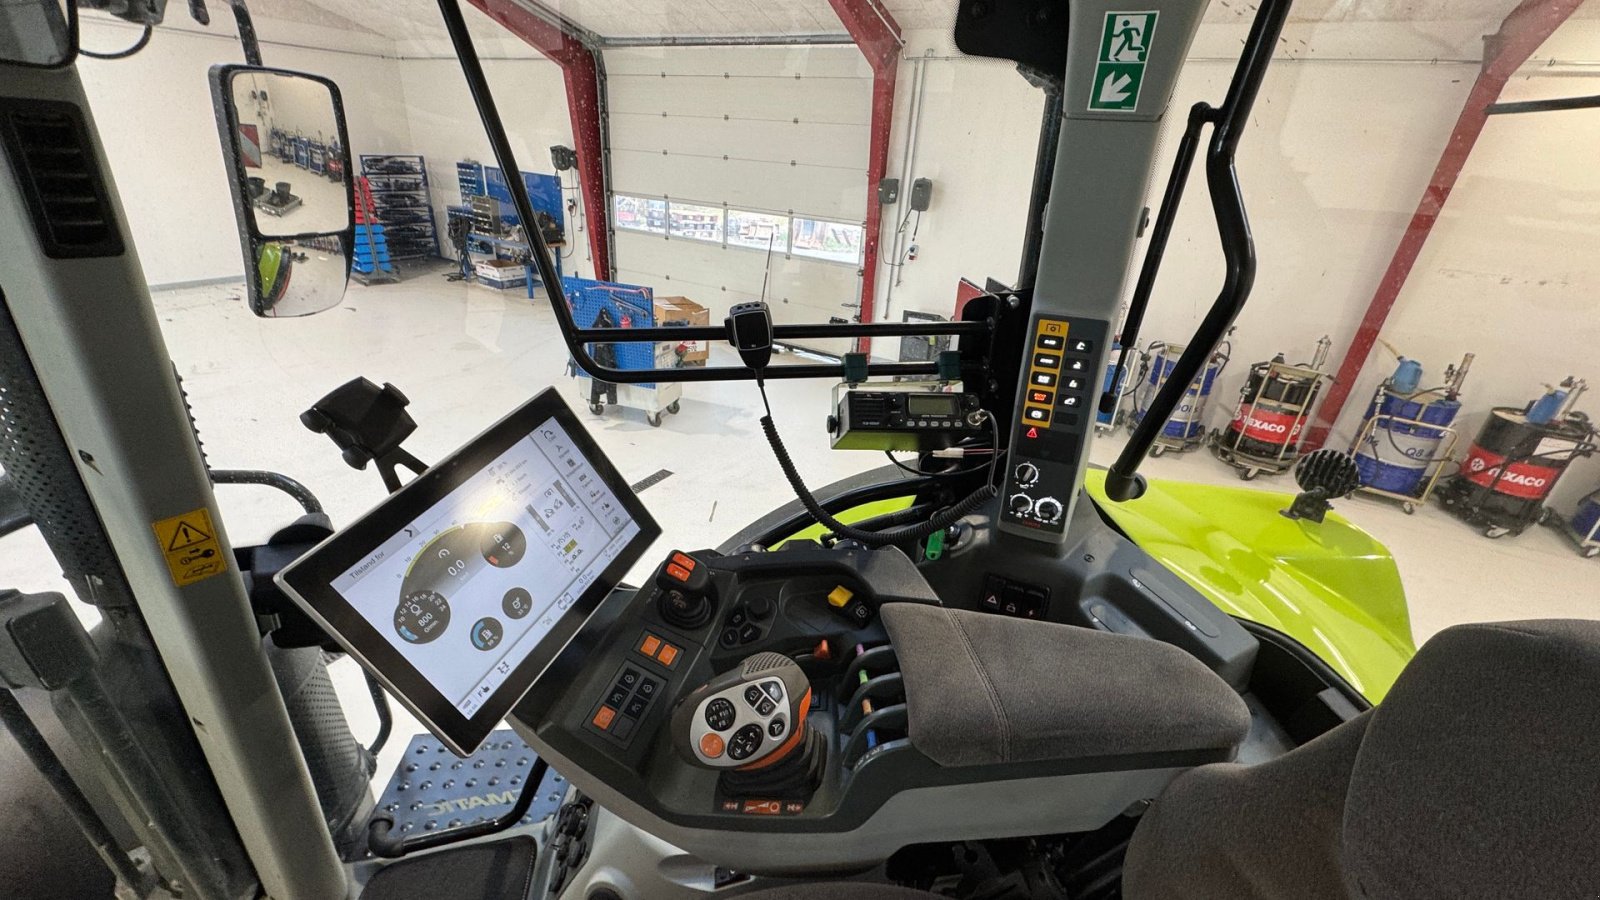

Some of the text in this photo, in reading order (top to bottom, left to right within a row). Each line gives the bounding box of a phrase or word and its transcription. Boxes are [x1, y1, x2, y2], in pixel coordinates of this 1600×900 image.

[502, 542, 511, 551] 12
[349, 551, 385, 579] Tilstand for
[447, 559, 465, 576] 0.0
[428, 594, 435, 602] 20
[418, 612, 433, 627] 800
